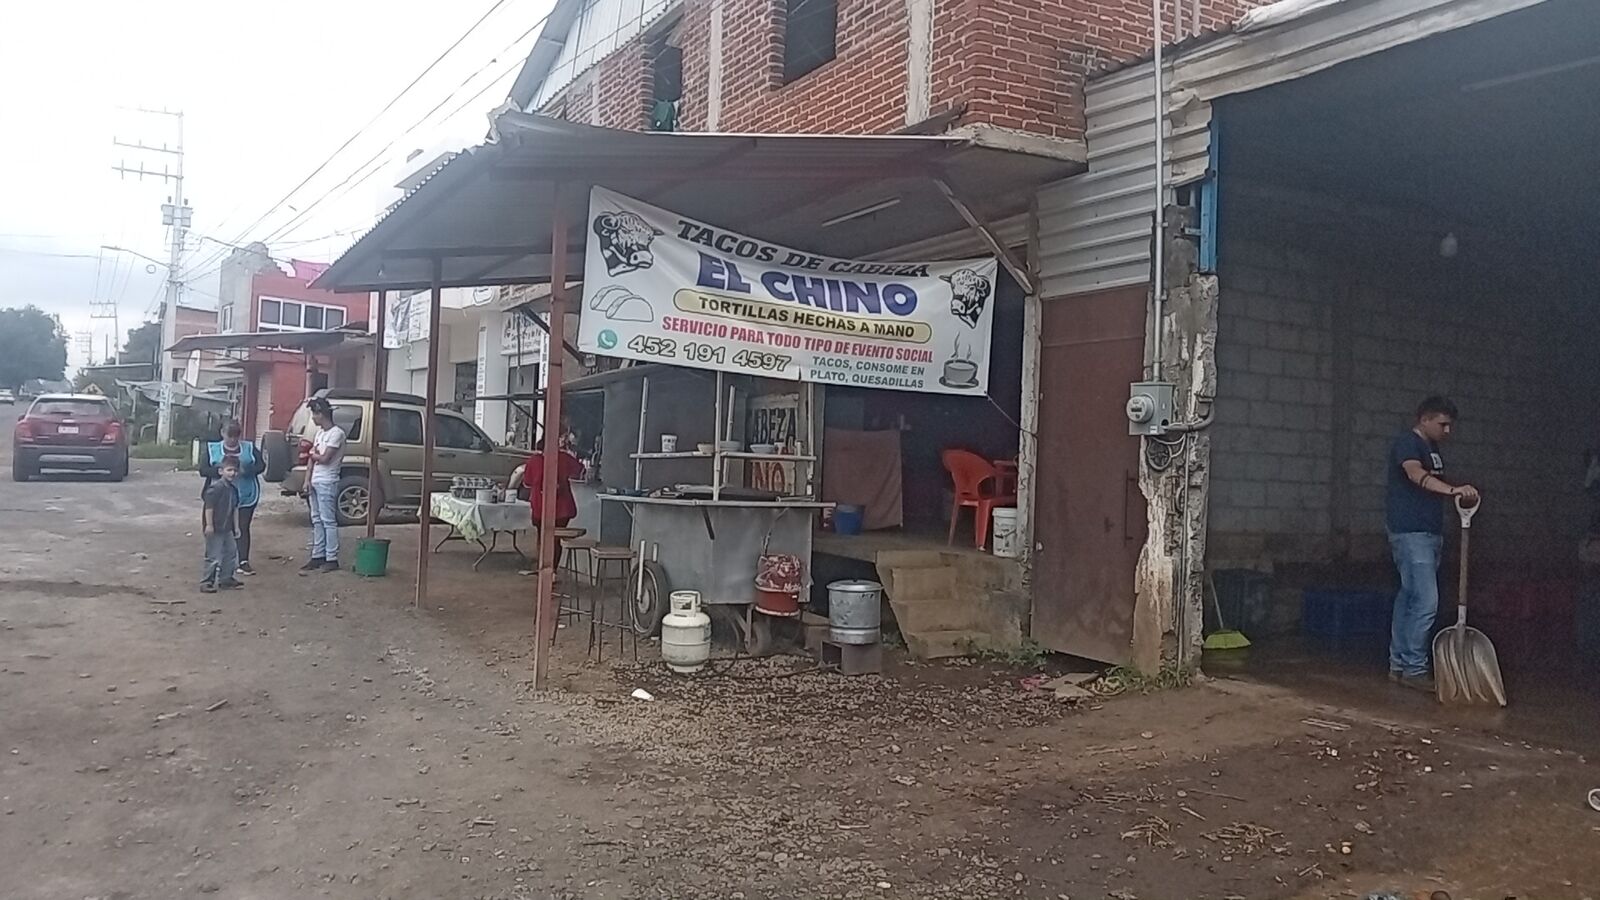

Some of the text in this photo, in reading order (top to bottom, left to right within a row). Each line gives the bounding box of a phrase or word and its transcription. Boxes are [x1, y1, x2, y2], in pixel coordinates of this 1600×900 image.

[677, 220, 930, 278] TACOS DE CABEZA
[696, 250, 918, 316] EL CHINO
[699, 296, 915, 338] TORTILLAS HECHAS A MANO
[628, 335, 791, 372] 452 191 4597
[662, 316, 934, 363] SERVICIO PARA TODO TIPO DE EVENTO SOCIAL
[810, 370, 924, 389] PLATO, QUESADILLAS
[813, 356, 925, 376] TACOS, CONSOME EN
